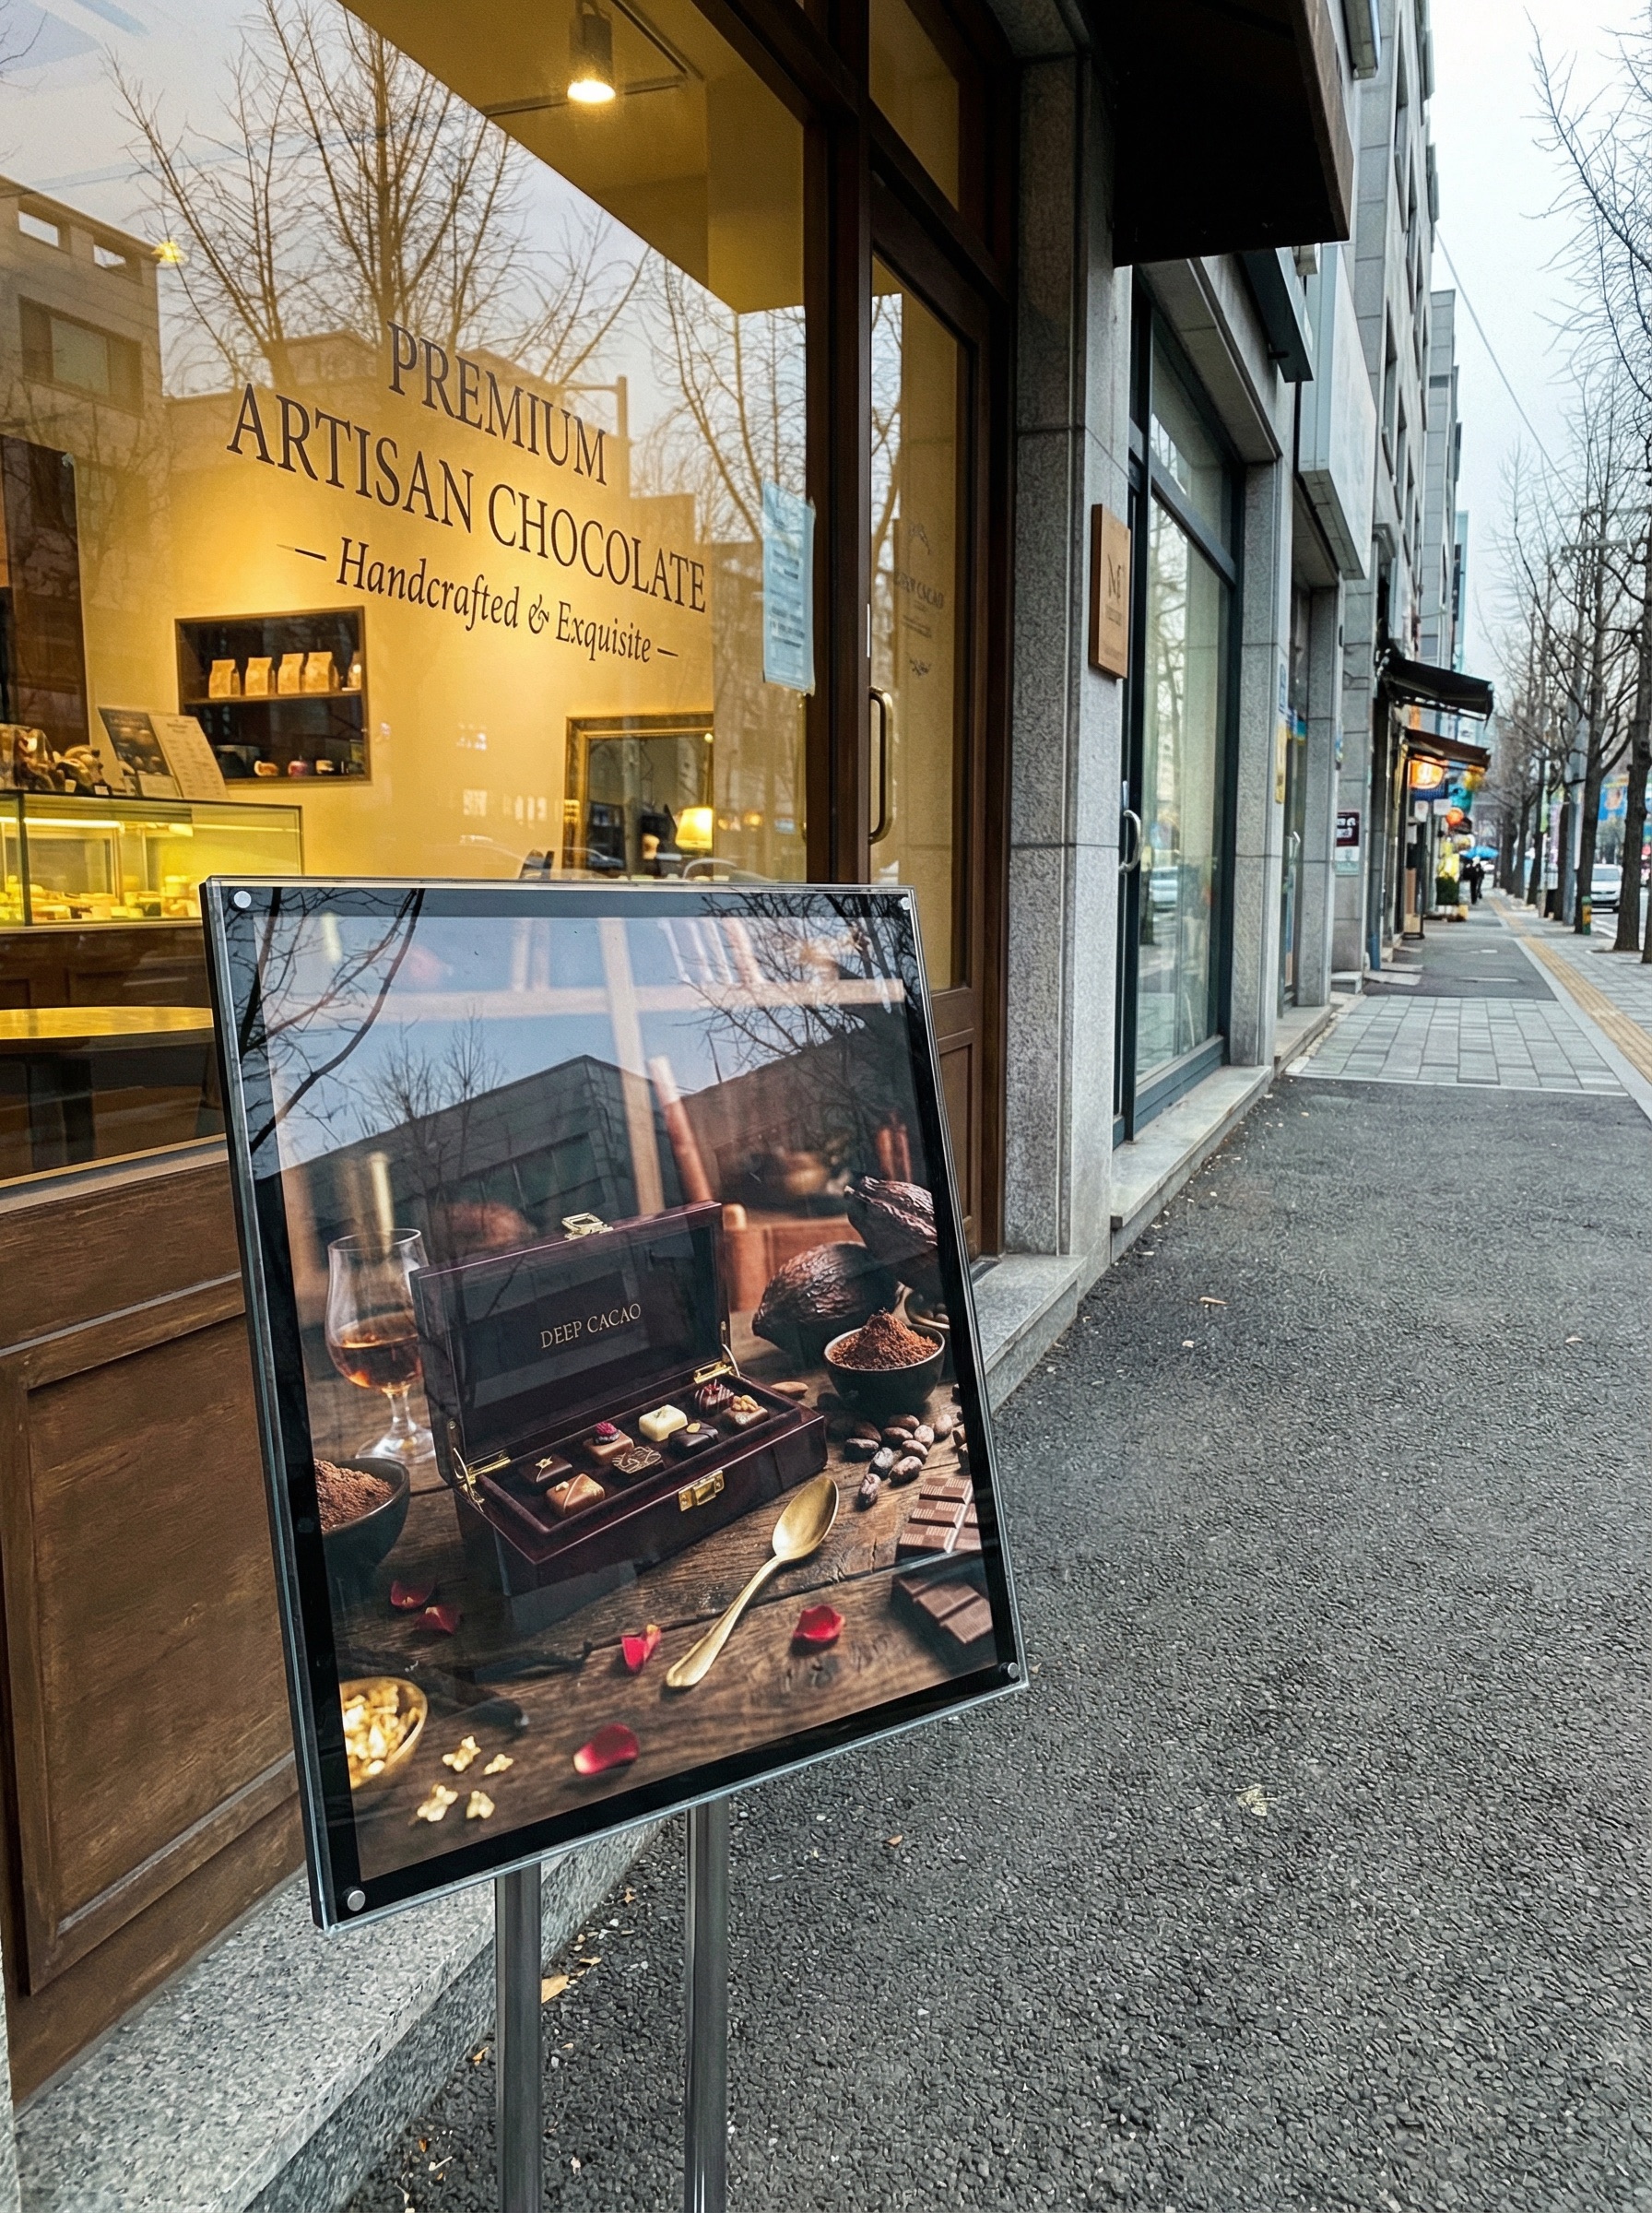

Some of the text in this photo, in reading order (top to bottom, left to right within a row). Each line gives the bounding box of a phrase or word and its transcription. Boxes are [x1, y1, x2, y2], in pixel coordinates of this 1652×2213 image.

[387, 321, 606, 485] PREMIUM
[227, 383, 705, 612] ARTISAN CHOCOLATE
[336, 537, 519, 631] Handcrafted
[528, 593, 549, 633] &
[556, 601, 651, 662] Exquisite
[540, 1303, 642, 1349] DEEP CACAO
